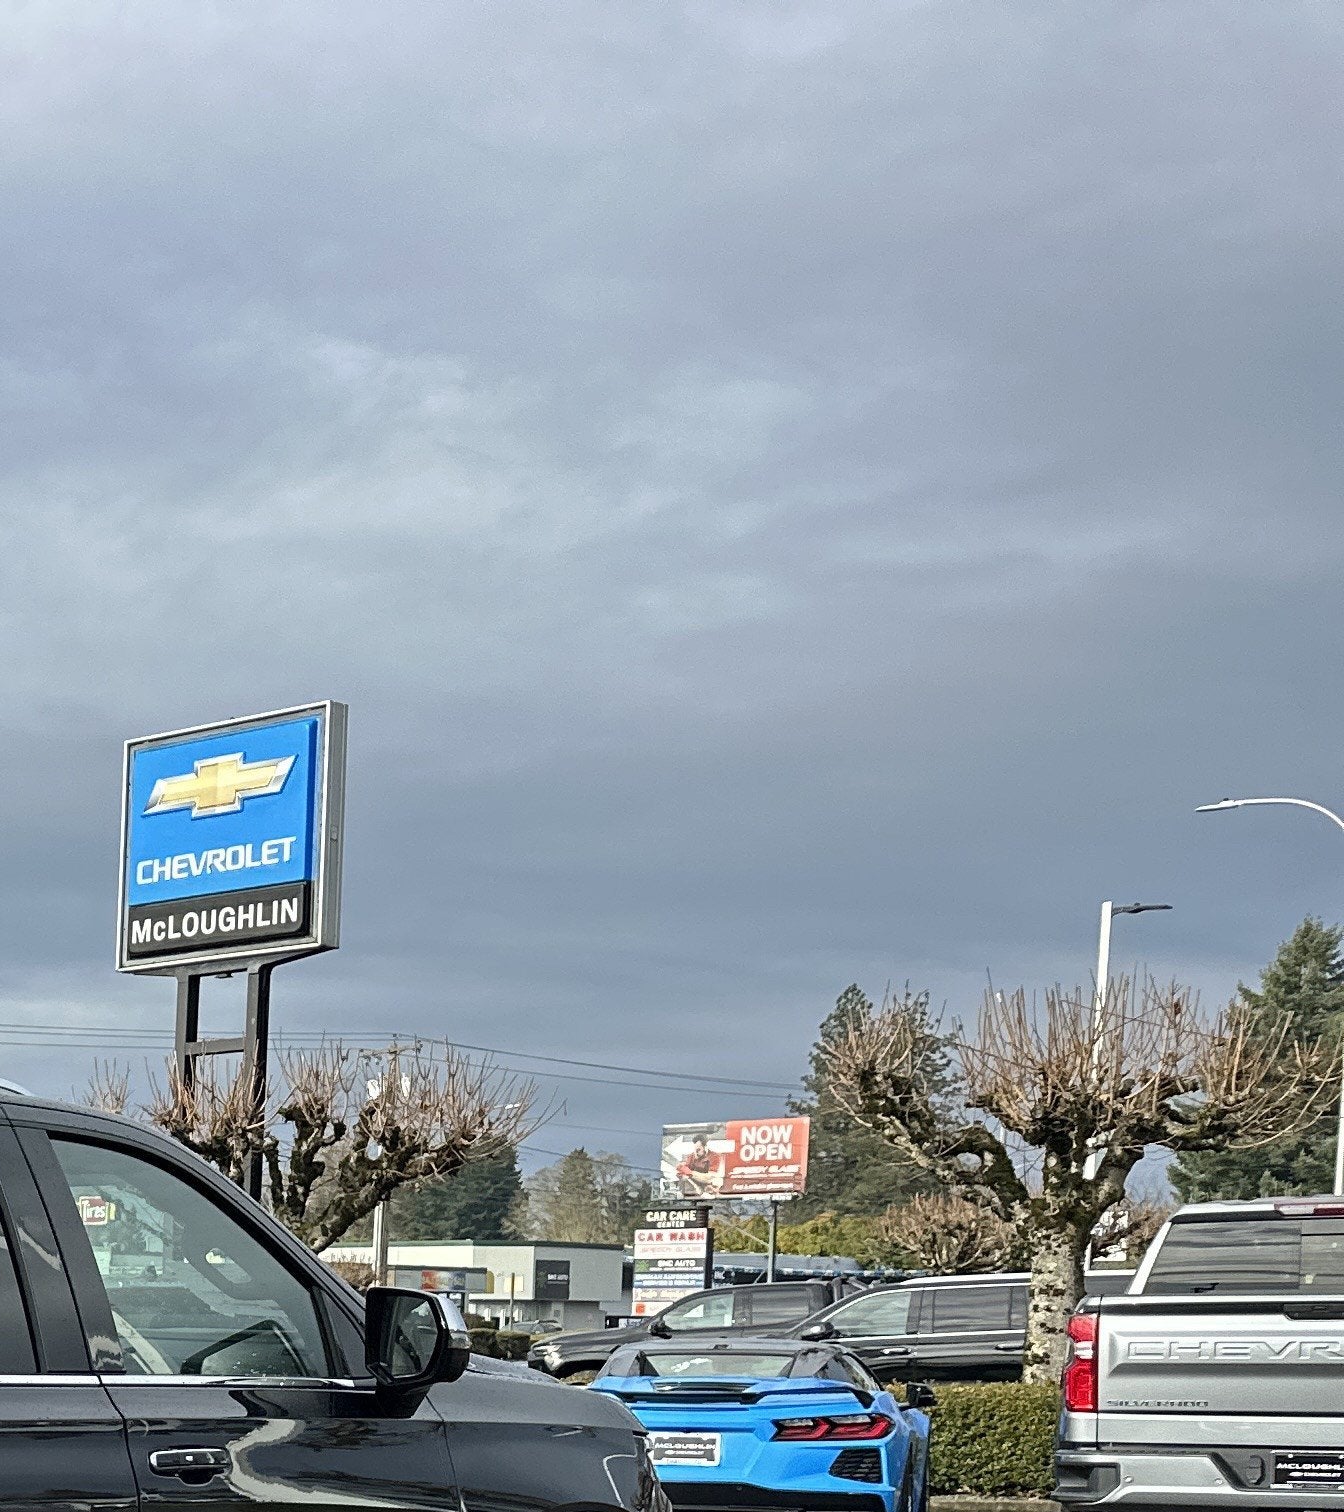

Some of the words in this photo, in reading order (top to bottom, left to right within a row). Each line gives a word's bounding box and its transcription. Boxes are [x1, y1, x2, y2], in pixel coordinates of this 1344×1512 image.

[136, 836, 297, 885] CHEVROLET
[131, 897, 298, 945] McLOUGHLIN
[740, 1124, 793, 1145] NOW
[739, 1142, 793, 1162] OPEN
[645, 1211, 667, 1222] CAR
[669, 1210, 697, 1221] CARE
[656, 1221, 685, 1229] CENTER
[637, 1232, 664, 1242] CAR
[669, 1231, 705, 1241] WASH
[1276, 1463, 1344, 1471] MCLOUGHL
